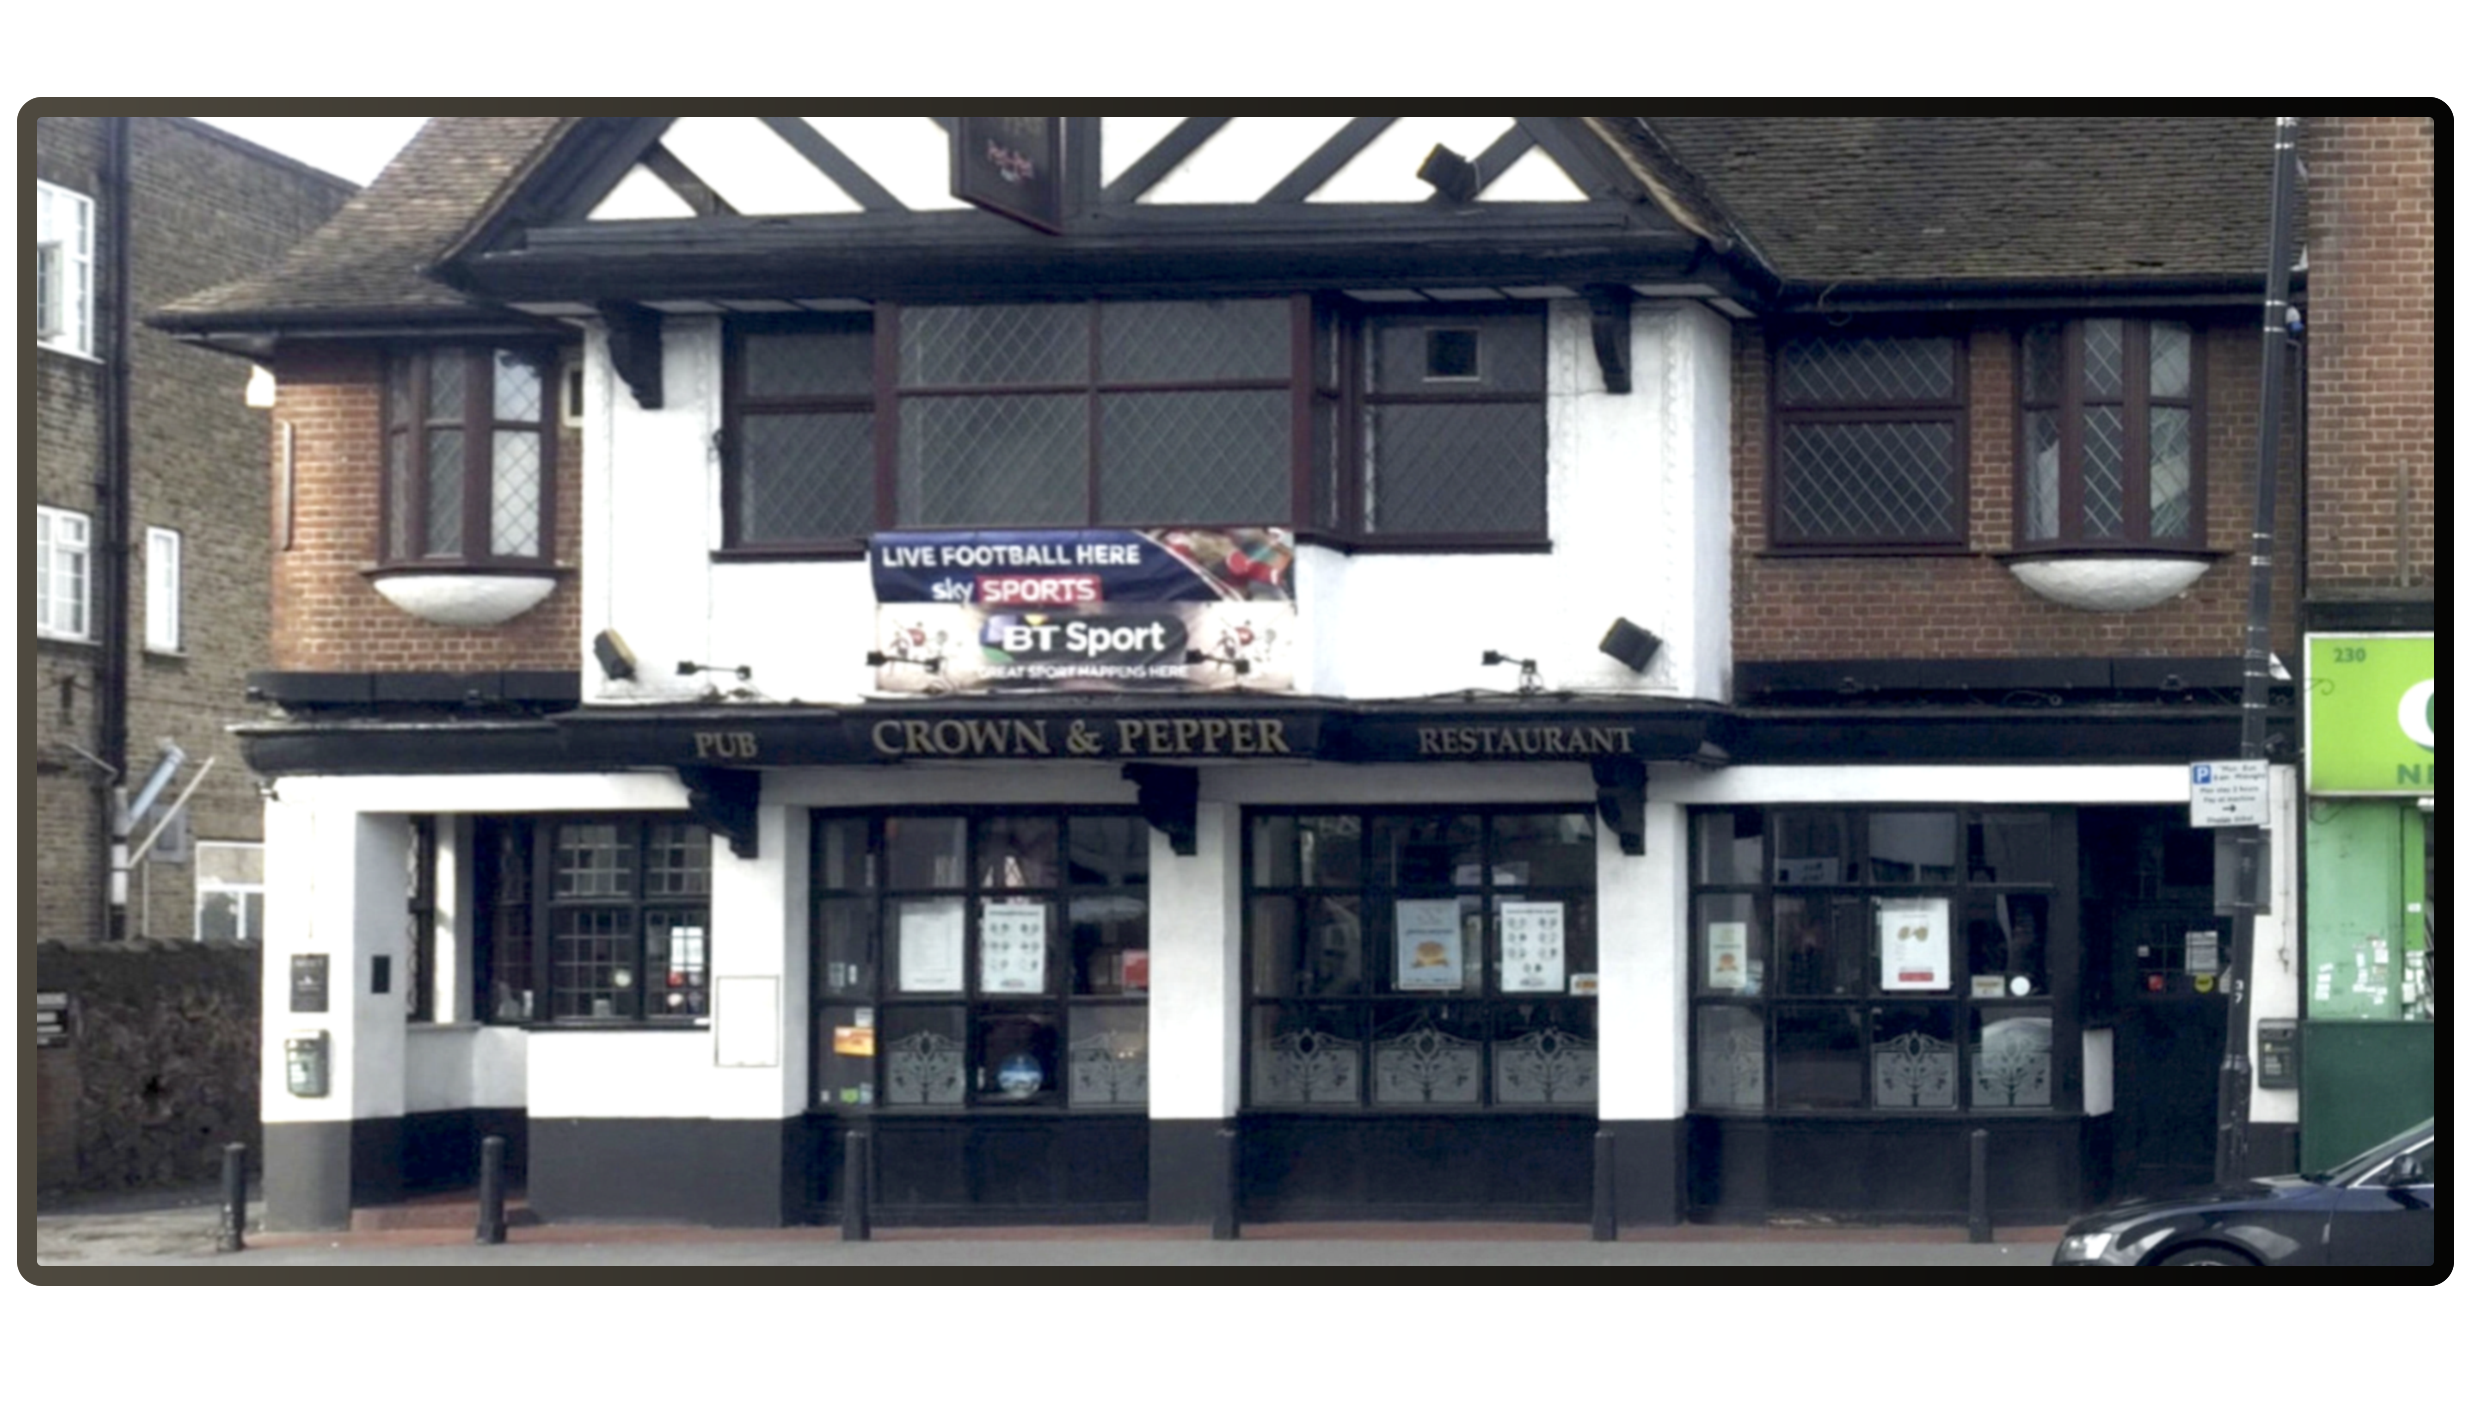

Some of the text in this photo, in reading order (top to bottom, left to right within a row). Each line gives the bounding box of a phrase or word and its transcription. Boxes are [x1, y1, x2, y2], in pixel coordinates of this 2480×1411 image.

[882, 544, 1140, 567] LIVE FOOTBALL HERE
[931, 577, 1096, 602] sky SPORTS
[1003, 621, 1165, 657] BT Sport
[2333, 647, 2367, 663] 230
[980, 664, 1189, 679] GREAT SPORT HAPPENS HERE
[694, 731, 758, 758] PUB
[871, 719, 1291, 755] CROWN & PEPPER
[1417, 726, 1636, 755] RESTAURANT
[2197, 766, 2209, 782] P
